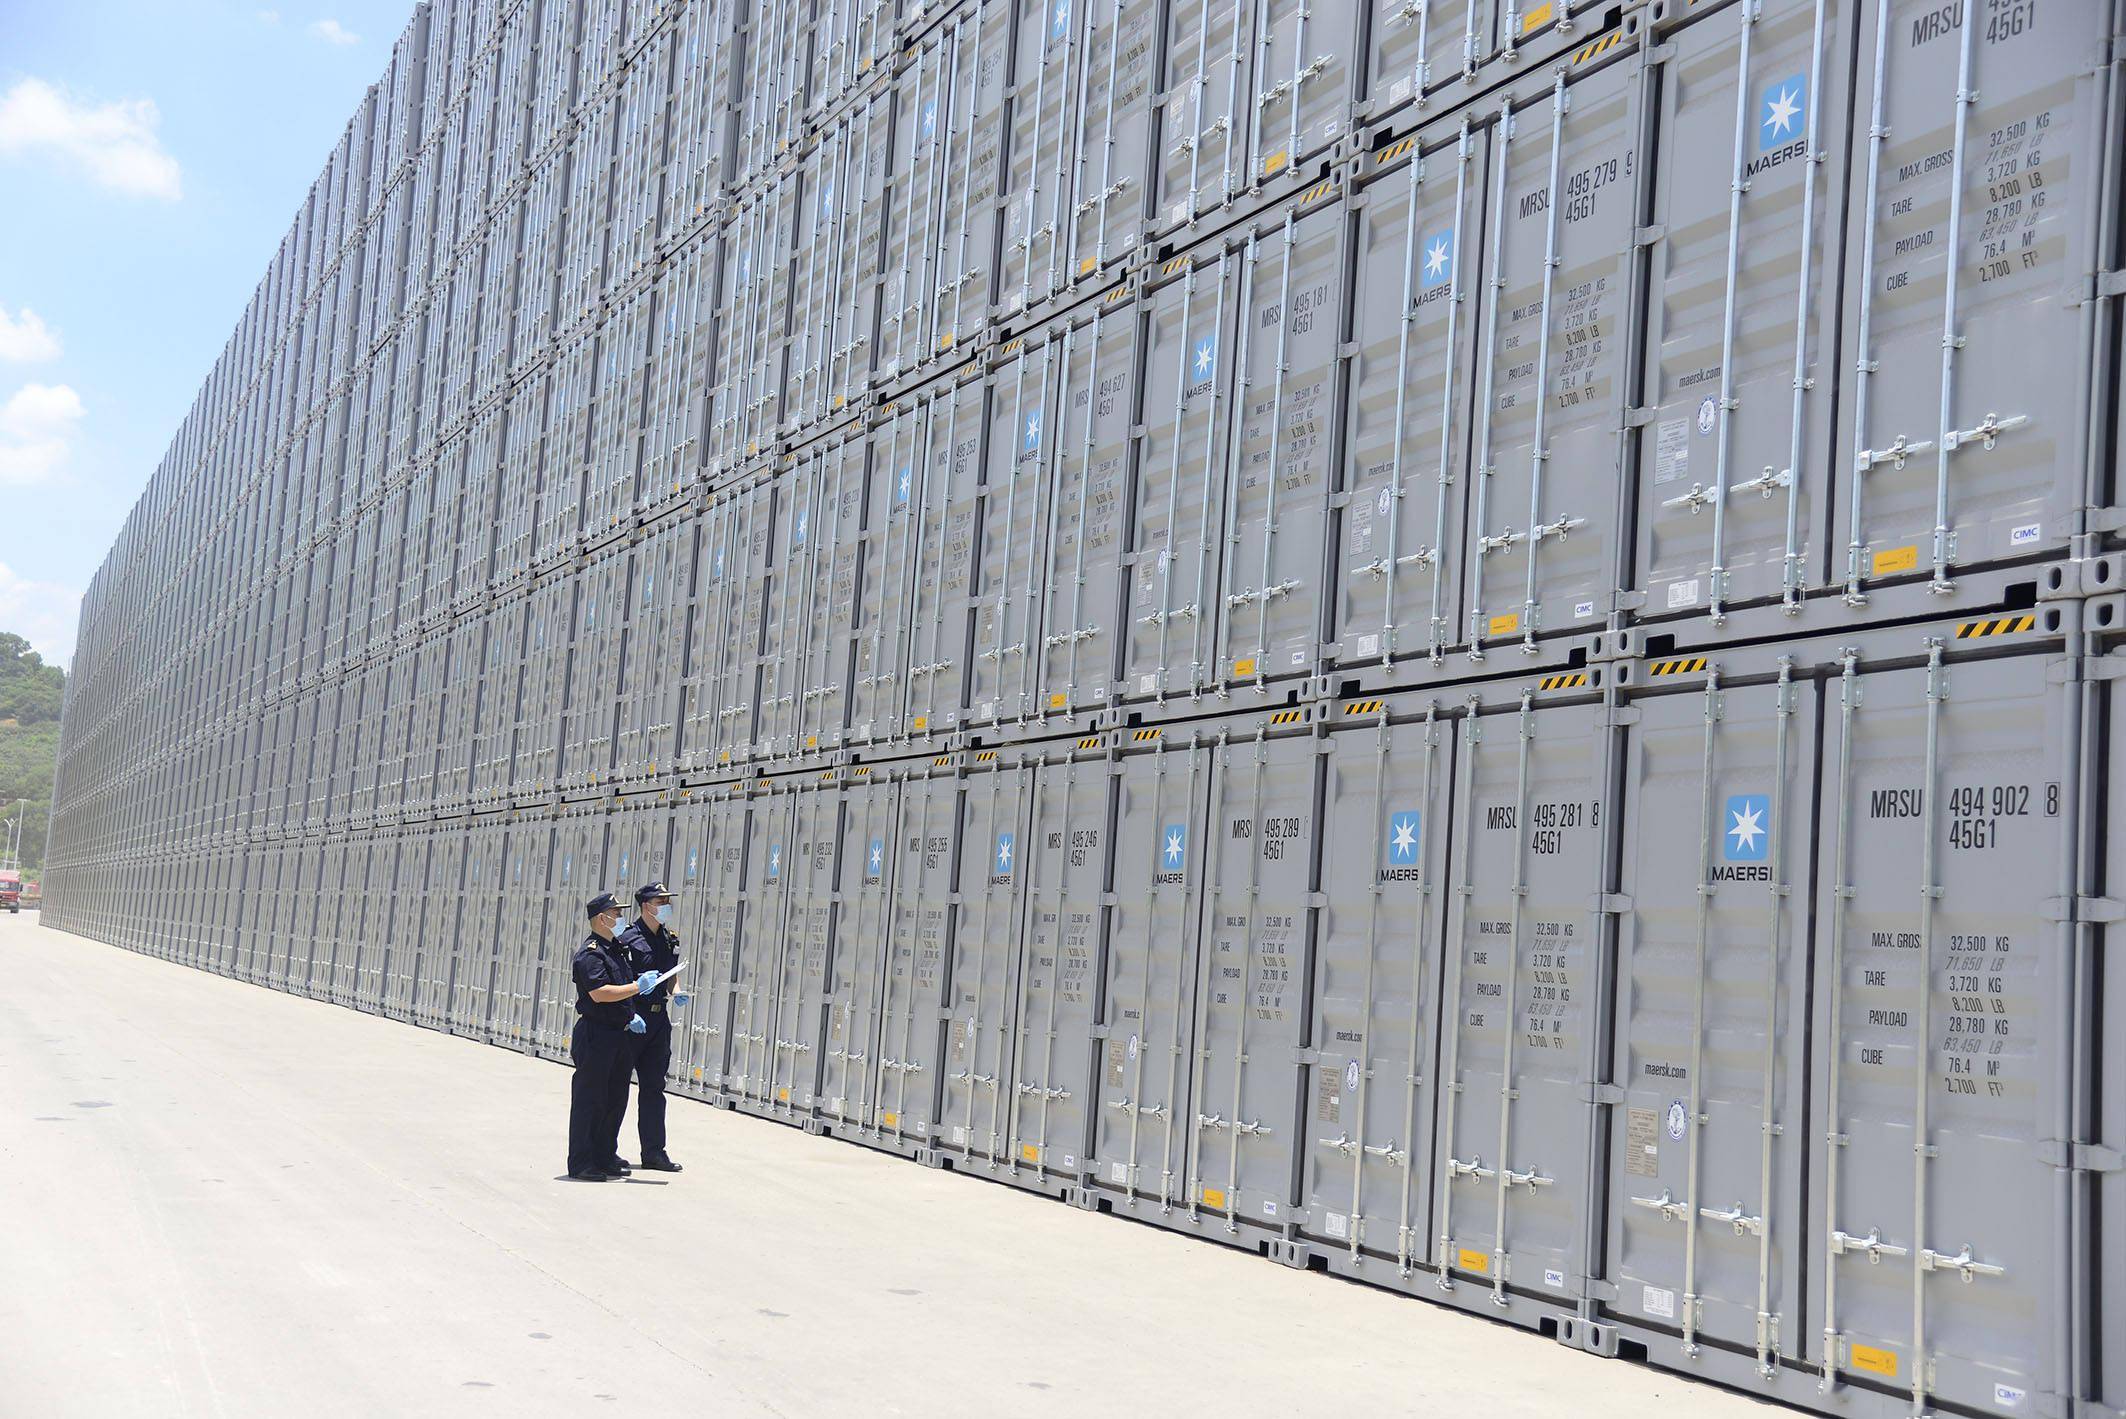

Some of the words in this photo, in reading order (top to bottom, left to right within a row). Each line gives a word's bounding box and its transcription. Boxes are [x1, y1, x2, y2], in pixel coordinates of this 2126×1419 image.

[1912, 5, 1963, 47] MRSU
[1986, 0, 2034, 44] 45G1
[1899, 158, 1923, 182] MAX.
[1924, 150, 1953, 172] GROSS
[2036, 112, 2050, 130] KG
[2030, 134, 2044, 148] LB
[1567, 170, 1590, 199] 495
[1593, 158, 1617, 190] 279
[1892, 198, 1913, 217] TARE
[2027, 151, 2040, 166] KG
[2031, 172, 2042, 189] LB
[1566, 192, 1596, 224] 45G1
[1895, 230, 1933, 255] PAYLOAD
[2032, 192, 2045, 209] KG
[2024, 212, 2039, 227] LB
[1596, 278, 1605, 292] KG
[1887, 272, 1908, 291] CUBE
[1294, 292, 1310, 314] 495
[1313, 284, 1327, 307] 181
[1413, 284, 1451, 308] MAERS
[1293, 311, 1313, 336] 45G1
[1506, 336, 1520, 349] TARE
[1589, 308, 1598, 322] KG
[1590, 324, 1599, 338] LB
[1508, 363, 1534, 380] PAYLOAD
[1593, 340, 1601, 354] KG
[1679, 367, 1721, 388] maersk.com
[1186, 381, 1212, 400] MAERS
[1501, 395, 1515, 409] CUBE
[2014, 528, 2038, 539] CIMC
[1871, 789, 1922, 818] MRSU
[1950, 787, 1984, 816] 494
[1992, 785, 2030, 815] 902
[2046, 784, 2059, 815] 8
[1534, 804, 1556, 828] 495
[1560, 803, 1582, 827] 281
[1592, 802, 1599, 826] 8
[1232, 820, 1252, 838] MRS
[1265, 818, 1280, 838] 495
[1283, 818, 1299, 838] 289
[1950, 819, 1997, 849] 45G1
[1048, 833, 1061, 849] MRS
[1072, 831, 1083, 848] 495
[1085, 830, 1097, 847] 246
[1532, 830, 1561, 854] 45G1
[1070, 850, 1085, 866] 45G1
[1264, 840, 1284, 859] 45G1
[991, 876, 1010, 885] MAERS
[1156, 873, 1183, 884] MAERS
[1380, 869, 1418, 881] MAERS
[1496, 922, 1511, 934] GROS
[1564, 923, 1573, 936] KG
[1872, 933, 1894, 947] MAX.
[1897, 933, 1921, 948] GROS
[1996, 936, 2009, 952] KG
[1473, 952, 1487, 964] TARE
[1557, 956, 1566, 968] KG
[1990, 958, 2004, 971] LB
[1558, 972, 1567, 985] LB
[1864, 970, 1886, 986] TARE
[1988, 977, 2001, 993] KG
[1477, 983, 1501, 996] PAYLOAD
[1561, 988, 1570, 1001] KG
[1991, 998, 2005, 1014] LB
[1470, 1014, 1484, 1027] CUBE
[1869, 1010, 1908, 1027] PAYLOAD
[1995, 1020, 2008, 1035] KG
[1989, 1040, 2003, 1054] LB
[1645, 1062, 1686, 1079] maersk.com
[1861, 1048, 1883, 1065] CUBE
[1949, 1057, 1970, 1074] 76.4
